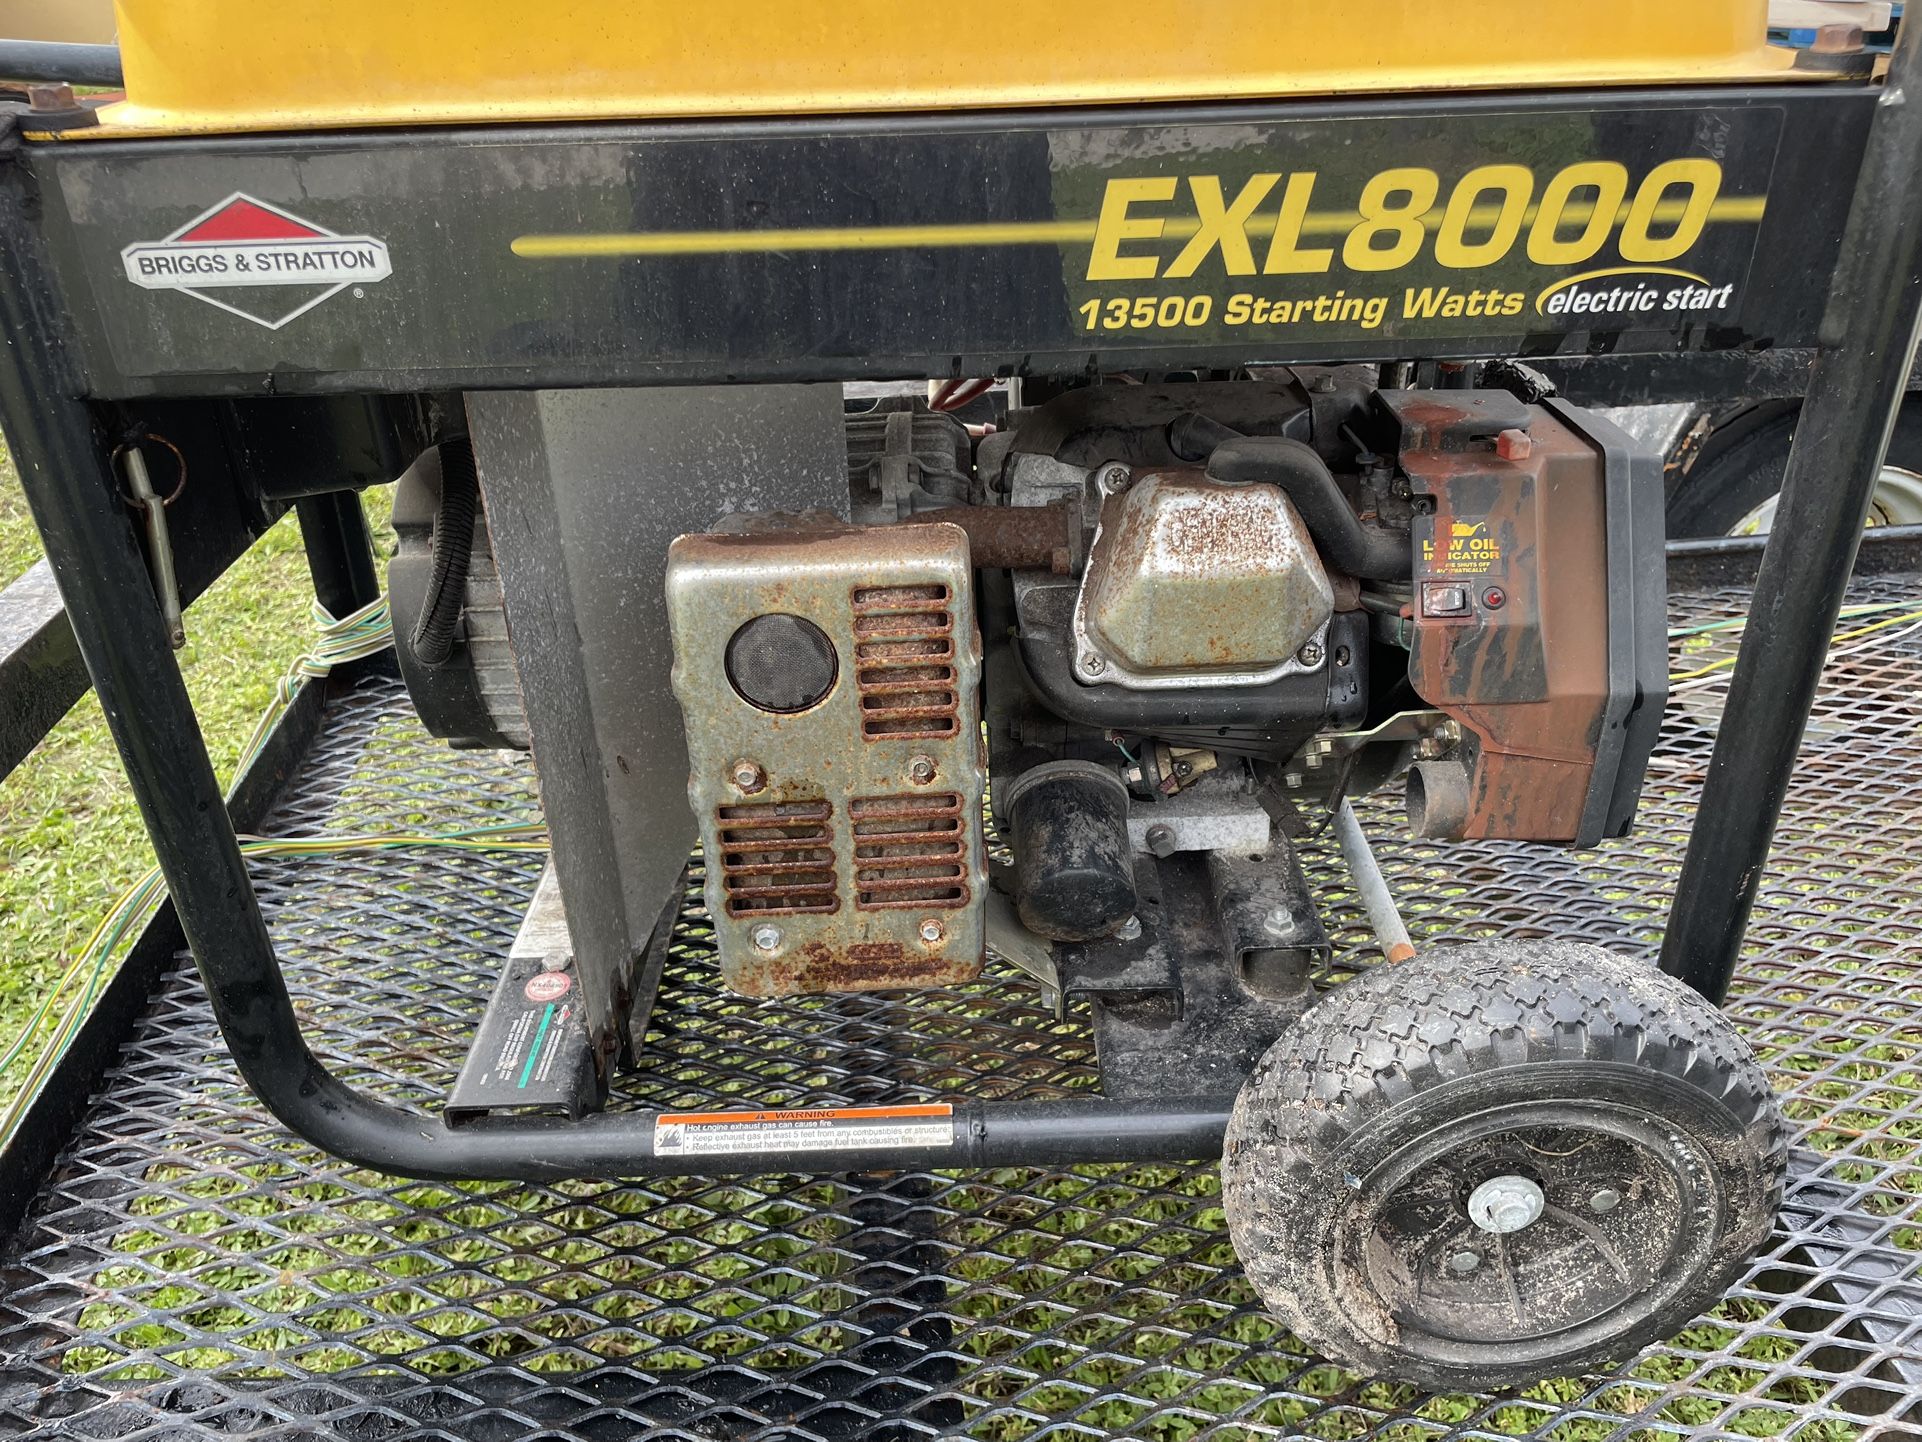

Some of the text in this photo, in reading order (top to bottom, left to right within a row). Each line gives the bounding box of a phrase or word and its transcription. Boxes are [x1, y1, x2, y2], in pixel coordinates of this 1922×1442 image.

[1086, 157, 1722, 280] EXL8000
[138, 250, 376, 275] BRIGGS & STRATTON
[1547, 282, 1734, 314] electric start
[1078, 286, 1524, 330] 13500 Starting Watts
[1423, 538, 1500, 551] LW OIL
[1423, 552, 1500, 560] INICATOR
[775, 1110, 835, 1119] WARNING
[703, 1124, 728, 1132] engine
[730, 1122, 760, 1130] exhaust
[762, 1122, 776, 1131] gas
[692, 1134, 712, 1142] Keep
[837, 1130, 851, 1138] any
[853, 1128, 901, 1136] combustibles
[692, 1142, 730, 1151] Reflective
[783, 1140, 800, 1149] may
[802, 1138, 832, 1148] damage
[870, 1136, 899, 1145] causing
